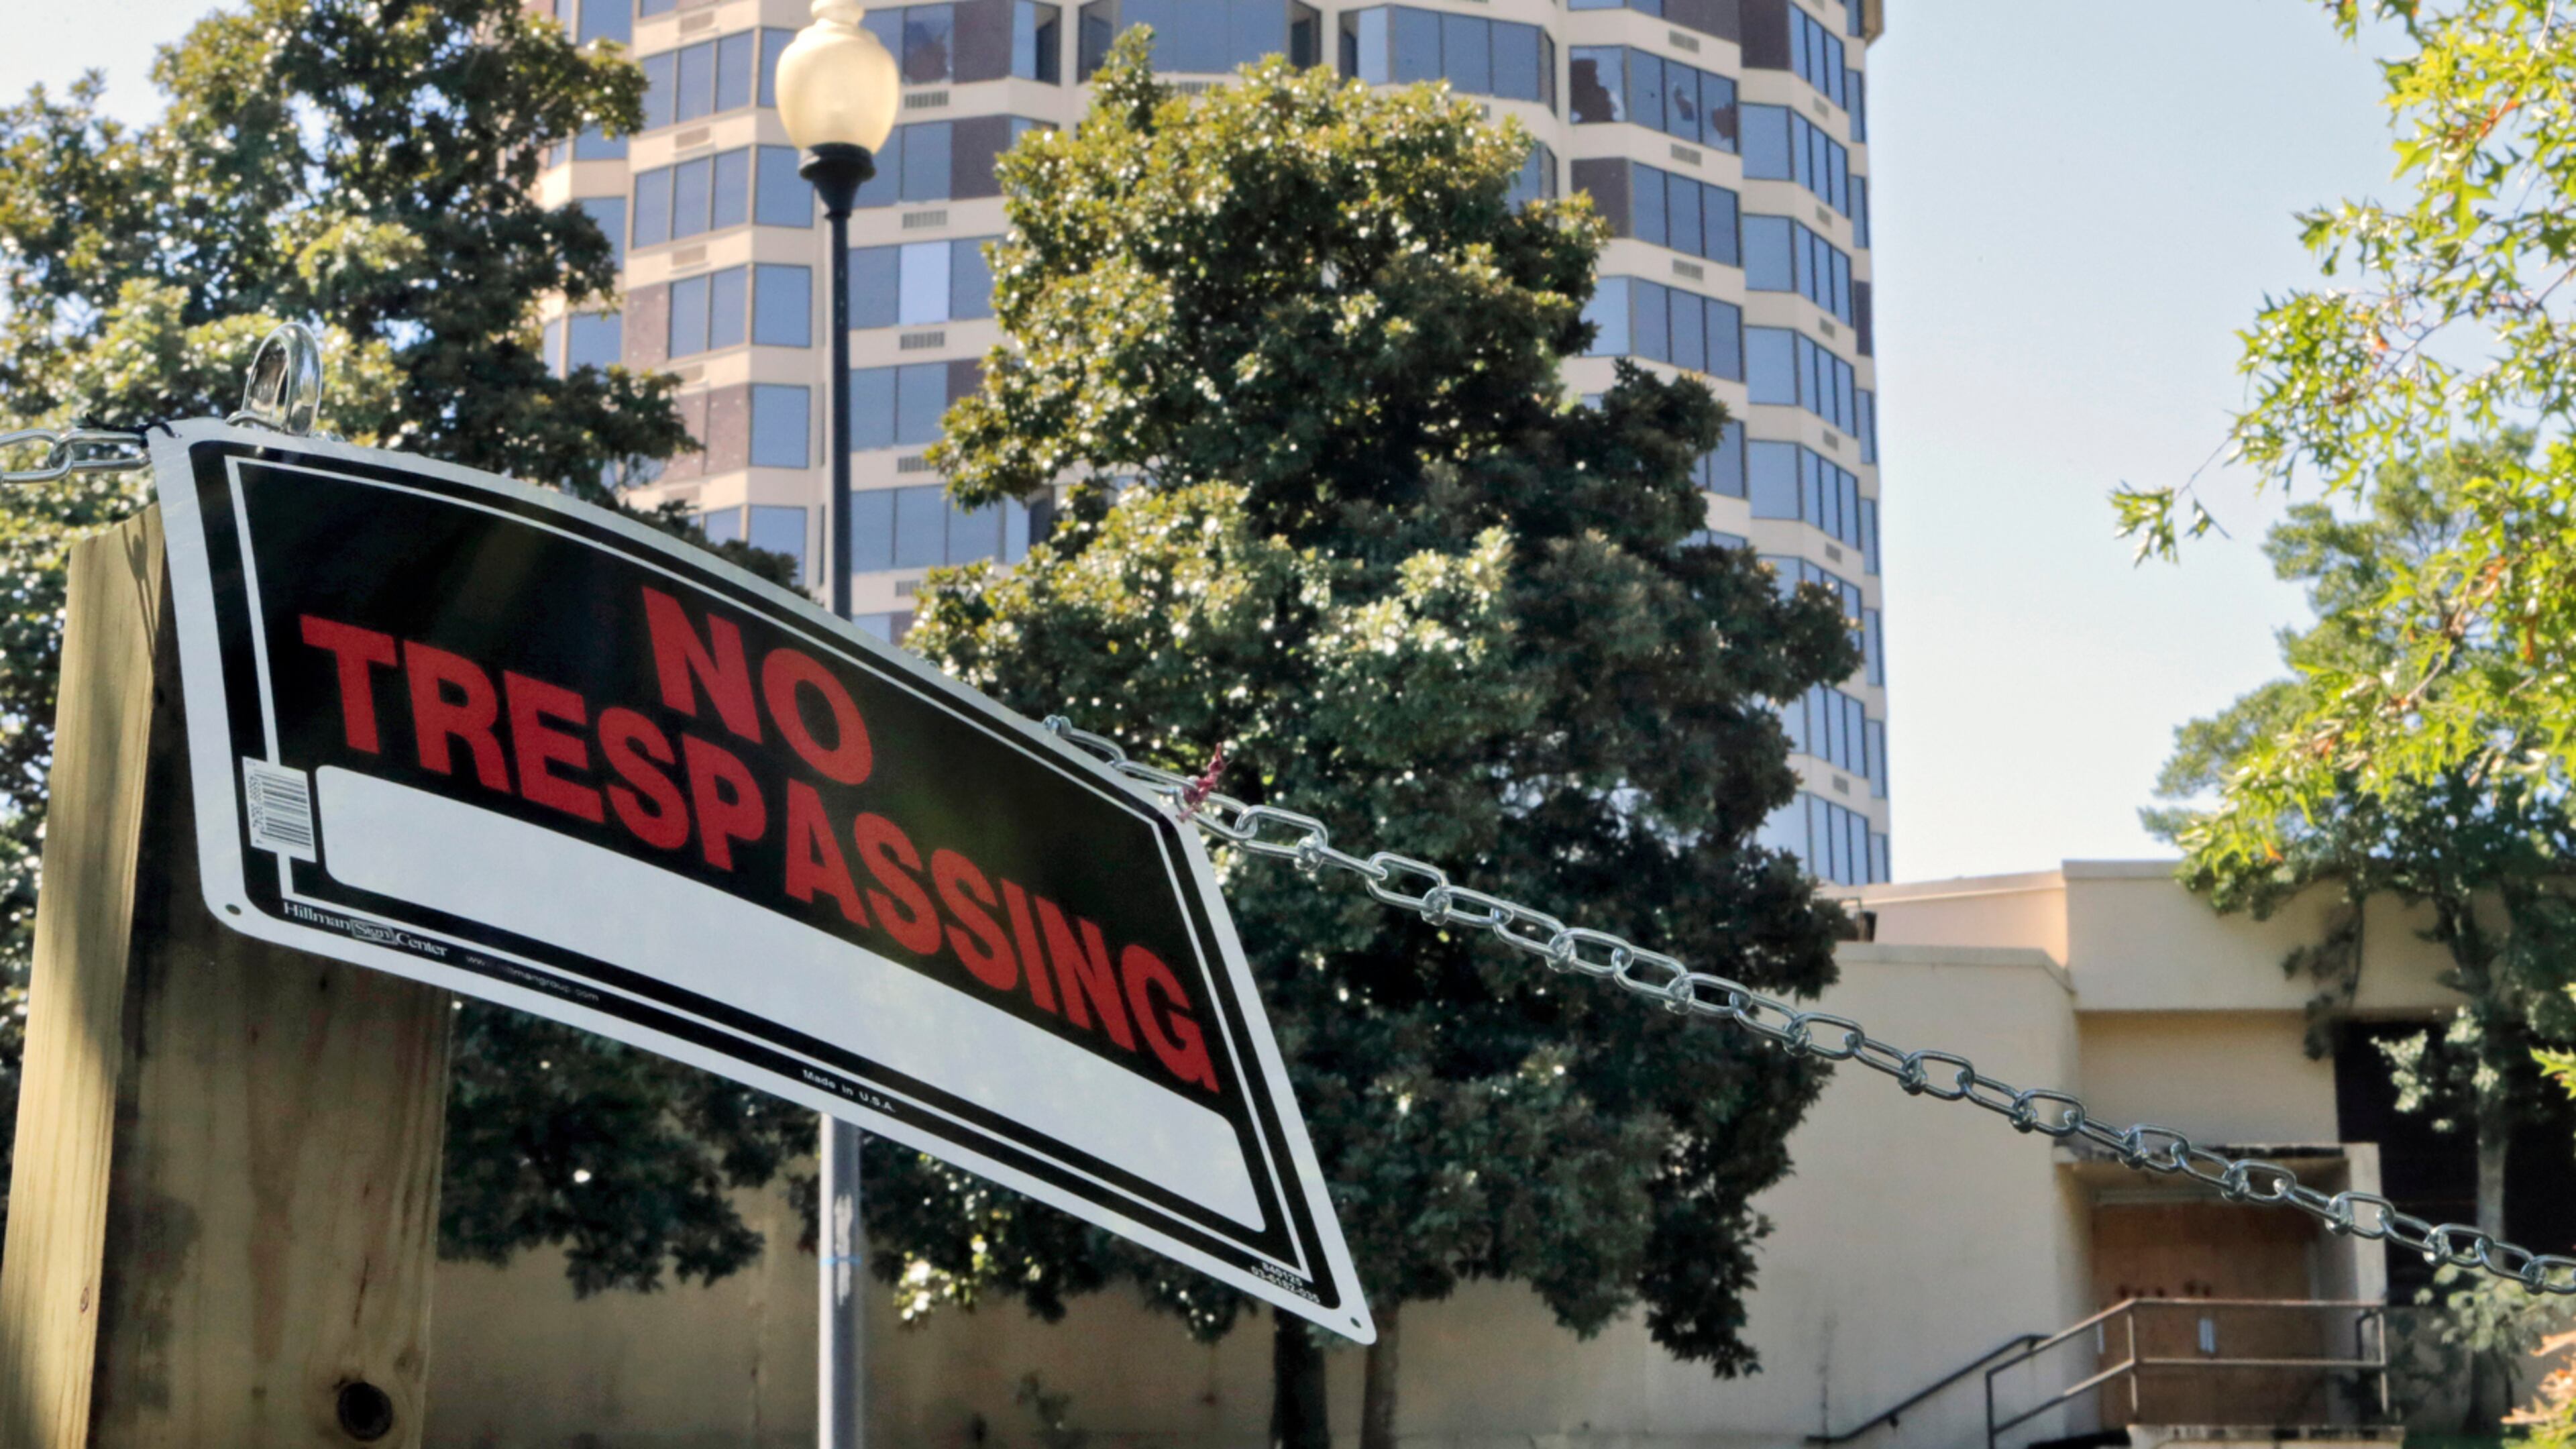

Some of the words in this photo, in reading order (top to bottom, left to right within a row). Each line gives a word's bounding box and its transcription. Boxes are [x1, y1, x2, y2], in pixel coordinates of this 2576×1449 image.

[642, 586, 874, 787] NO
[301, 614, 1220, 1093] TRESPASSING
[284, 902, 351, 930] Hillman
[354, 922, 393, 941] Sign
[396, 932, 448, 957] Center
[803, 1069, 836, 1089] Made
[841, 1083, 854, 1096] in
[859, 1091, 896, 1113] U.S.A.
